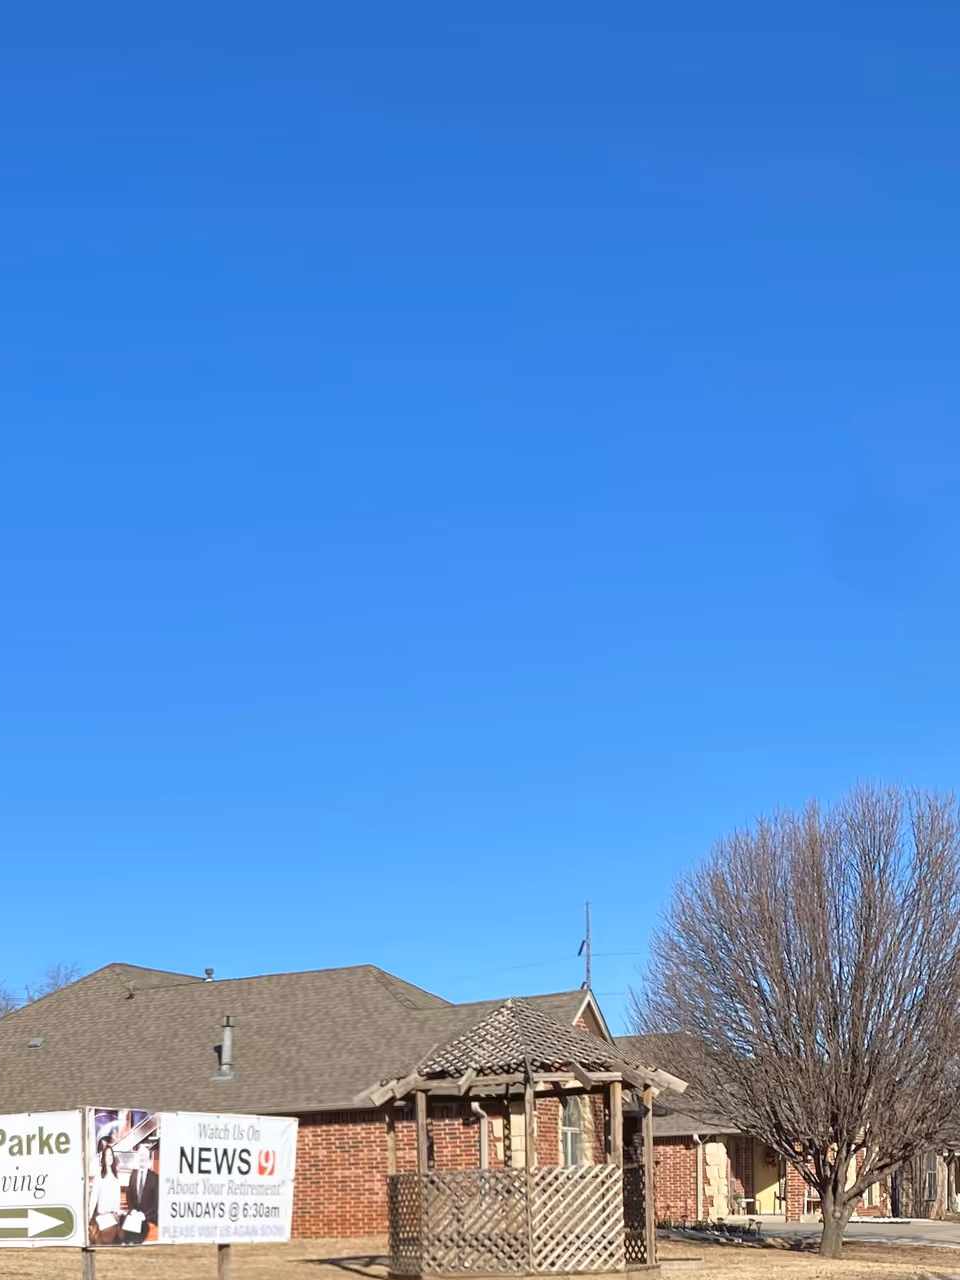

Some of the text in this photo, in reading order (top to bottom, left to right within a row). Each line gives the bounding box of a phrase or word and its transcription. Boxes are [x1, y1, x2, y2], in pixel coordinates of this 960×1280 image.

[198, 1122, 261, 1141] Watch Us On
[179, 1146, 276, 1176] NEWS 9
[202, 1179, 225, 1196] Your
[170, 1202, 280, 1222] SUNDAYS @ 6:30am
[161, 1224, 195, 1239] PLEASE
